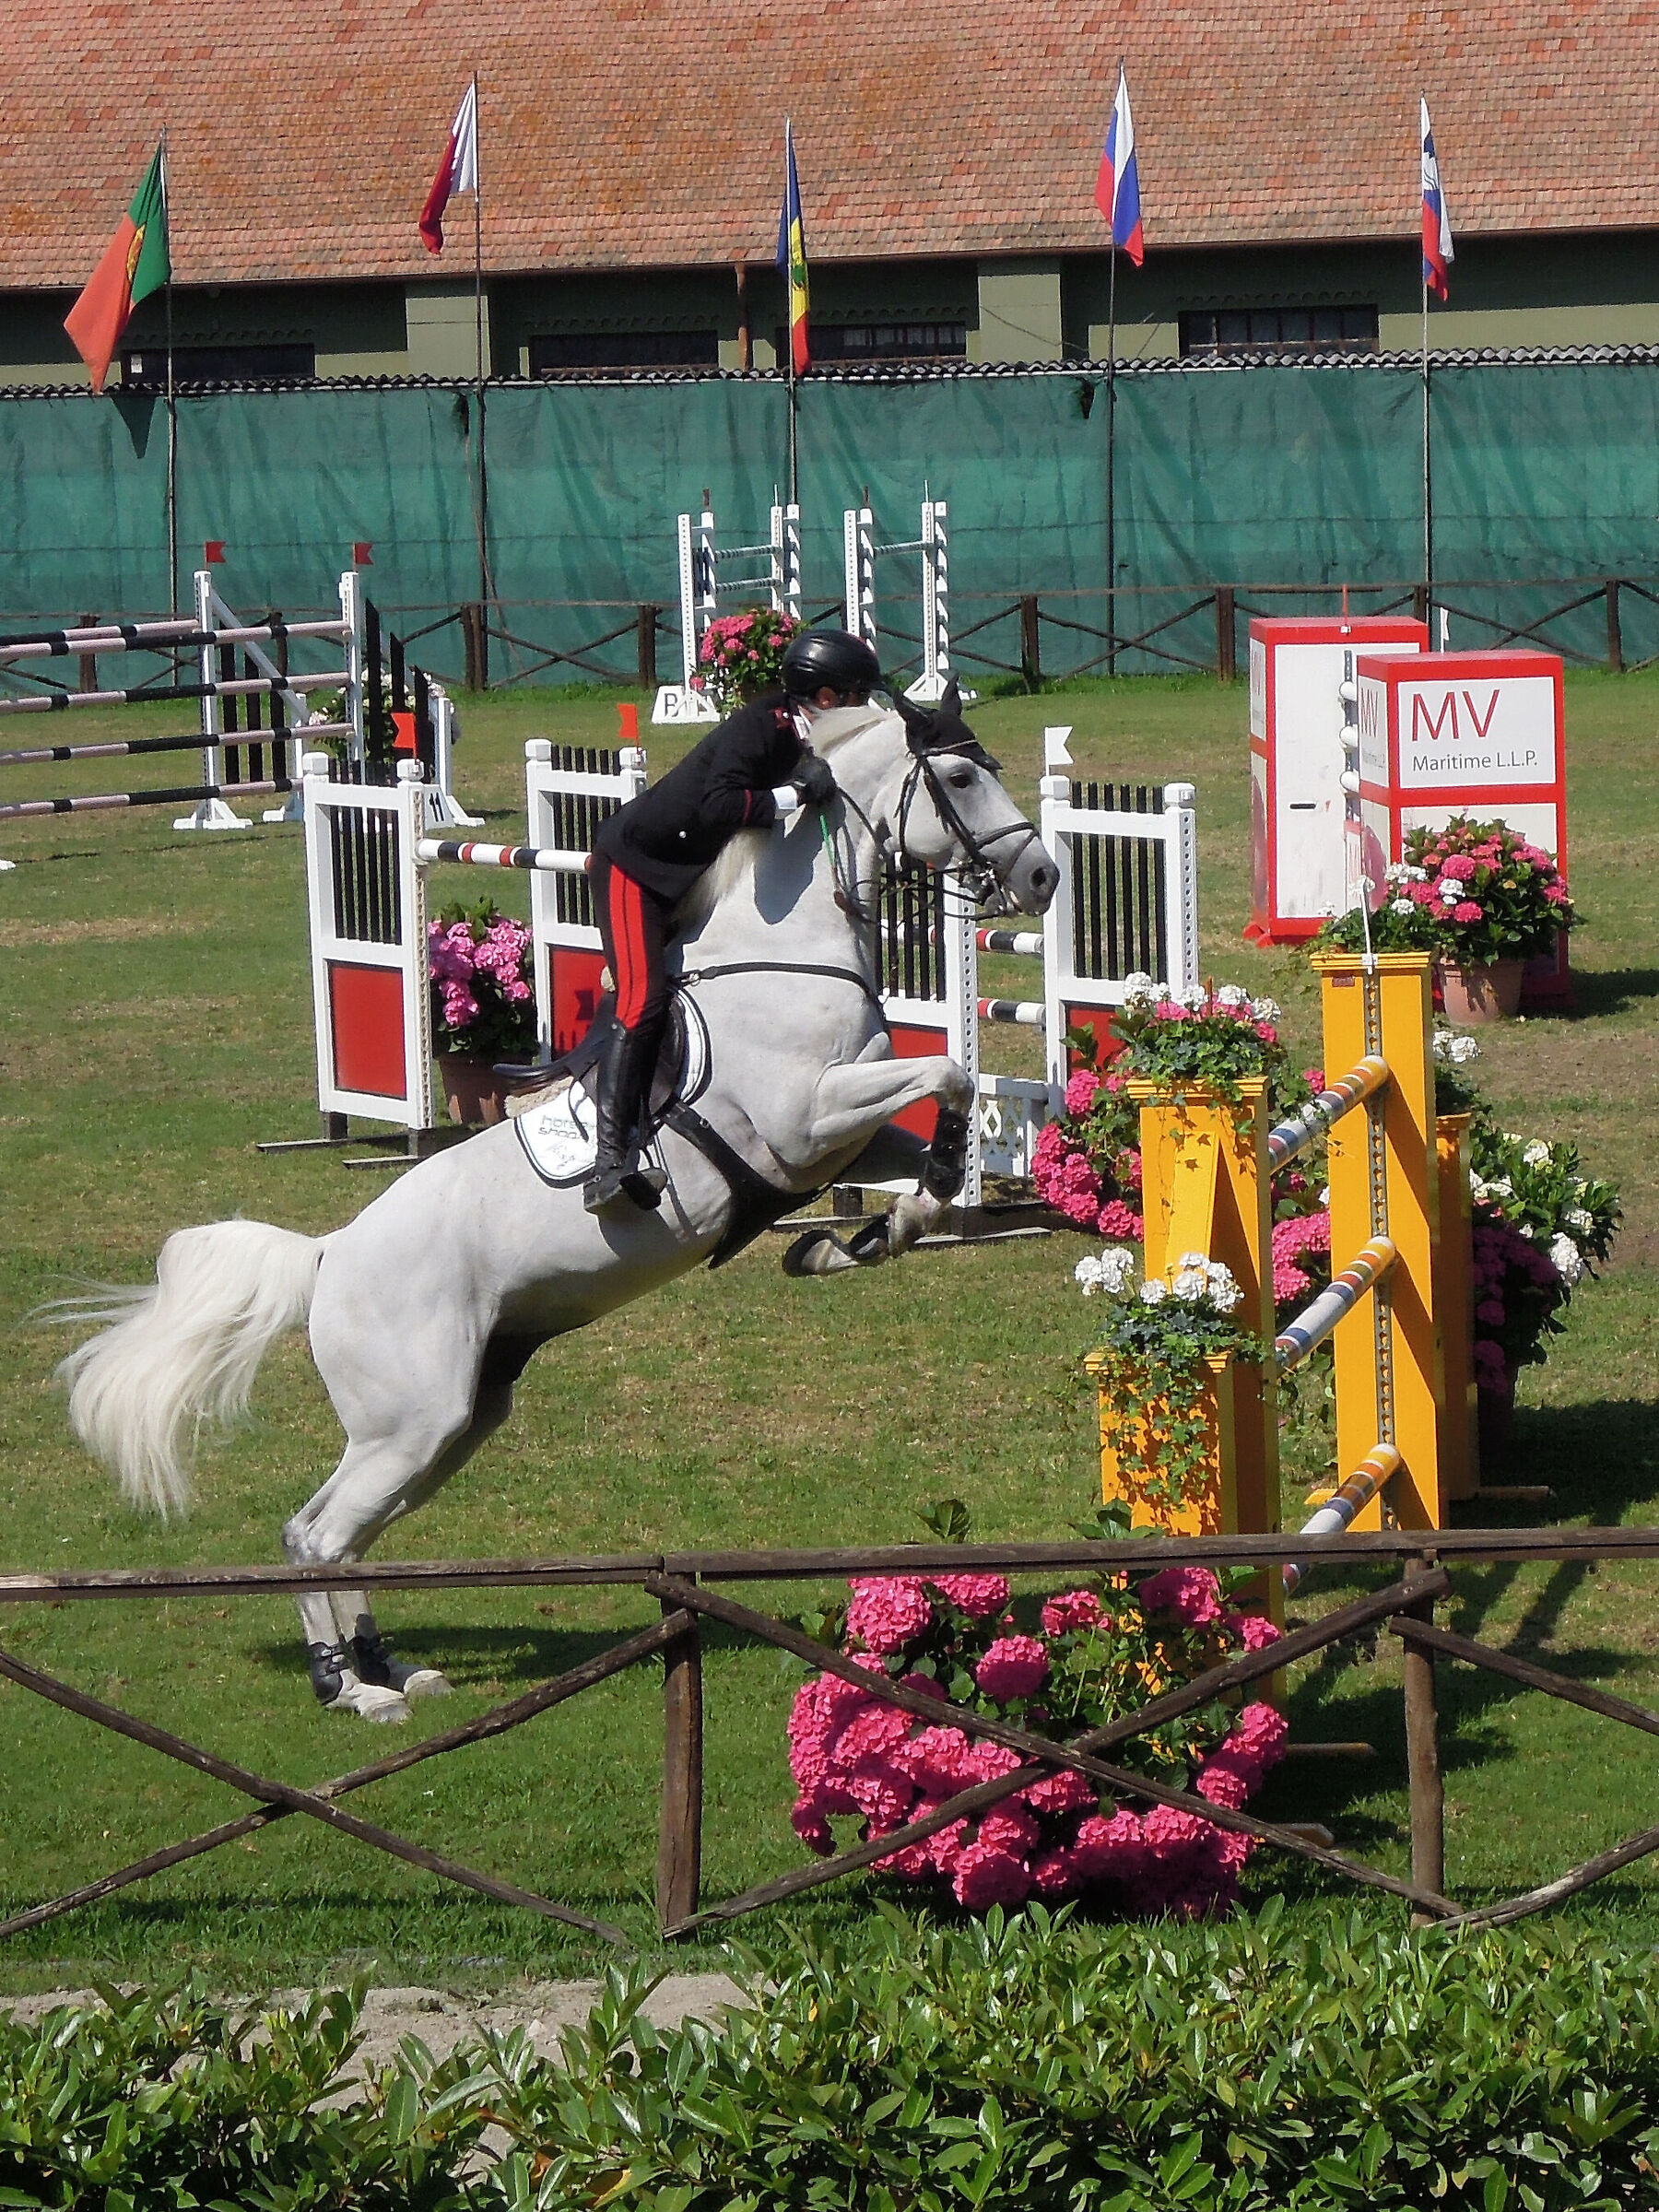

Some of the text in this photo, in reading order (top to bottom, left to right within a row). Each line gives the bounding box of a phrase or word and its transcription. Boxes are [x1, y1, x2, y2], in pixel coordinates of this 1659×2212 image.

[1412, 689, 1500, 741] MV
[1413, 750, 1537, 771] Maritime L.L.P.
[429, 793, 444, 822] 11
